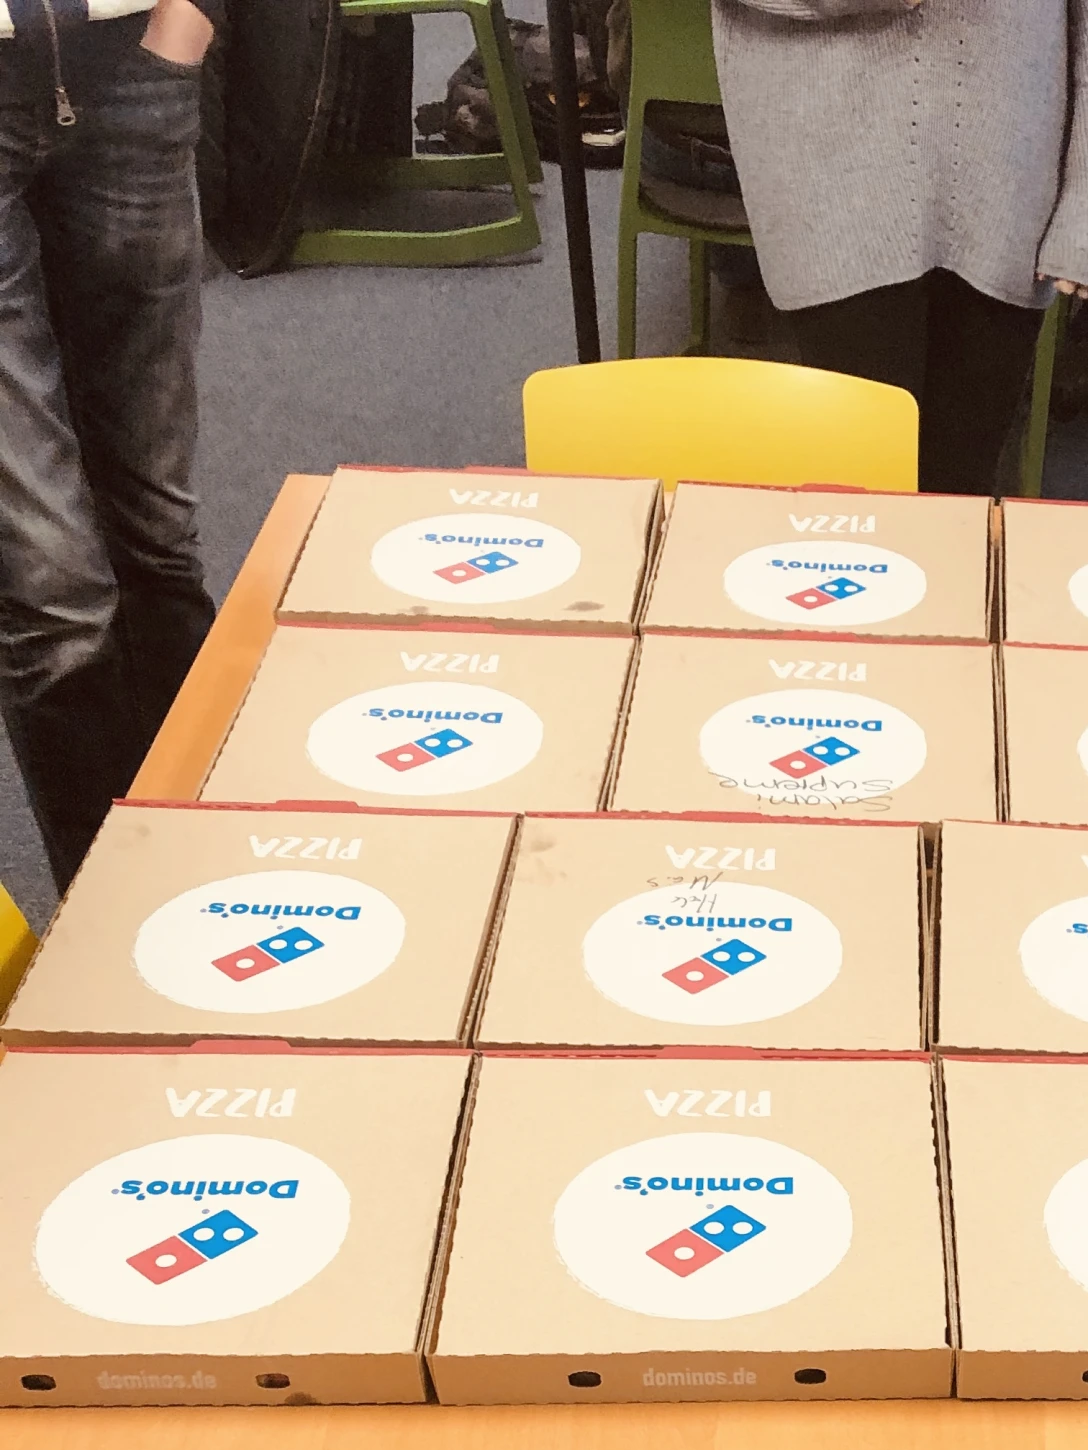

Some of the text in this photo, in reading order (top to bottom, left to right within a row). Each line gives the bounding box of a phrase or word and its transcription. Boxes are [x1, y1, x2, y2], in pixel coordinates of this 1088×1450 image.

[449, 488, 539, 509] PIZZA
[788, 513, 876, 534] PIZZA
[424, 533, 545, 548] Domino's
[771, 559, 889, 574] Domino's
[400, 651, 500, 674] PIZZA
[768, 659, 867, 682] PIZZA
[368, 707, 504, 725] Domino's
[751, 714, 883, 732] Domino's
[708, 771, 893, 792] Supreme
[758, 794, 893, 812] Salami
[249, 835, 363, 861] PIZZA
[665, 844, 776, 871] PIZZA
[207, 902, 362, 922] Domino's
[643, 914, 793, 933] Domino's
[165, 1087, 297, 1118] PIZZA
[643, 1088, 772, 1118] PIZZA
[120, 1179, 300, 1202] Domino's
[621, 1175, 795, 1198] Domino's
[96, 1369, 217, 1390] dominos.de
[642, 1367, 757, 1387] dominos.de
